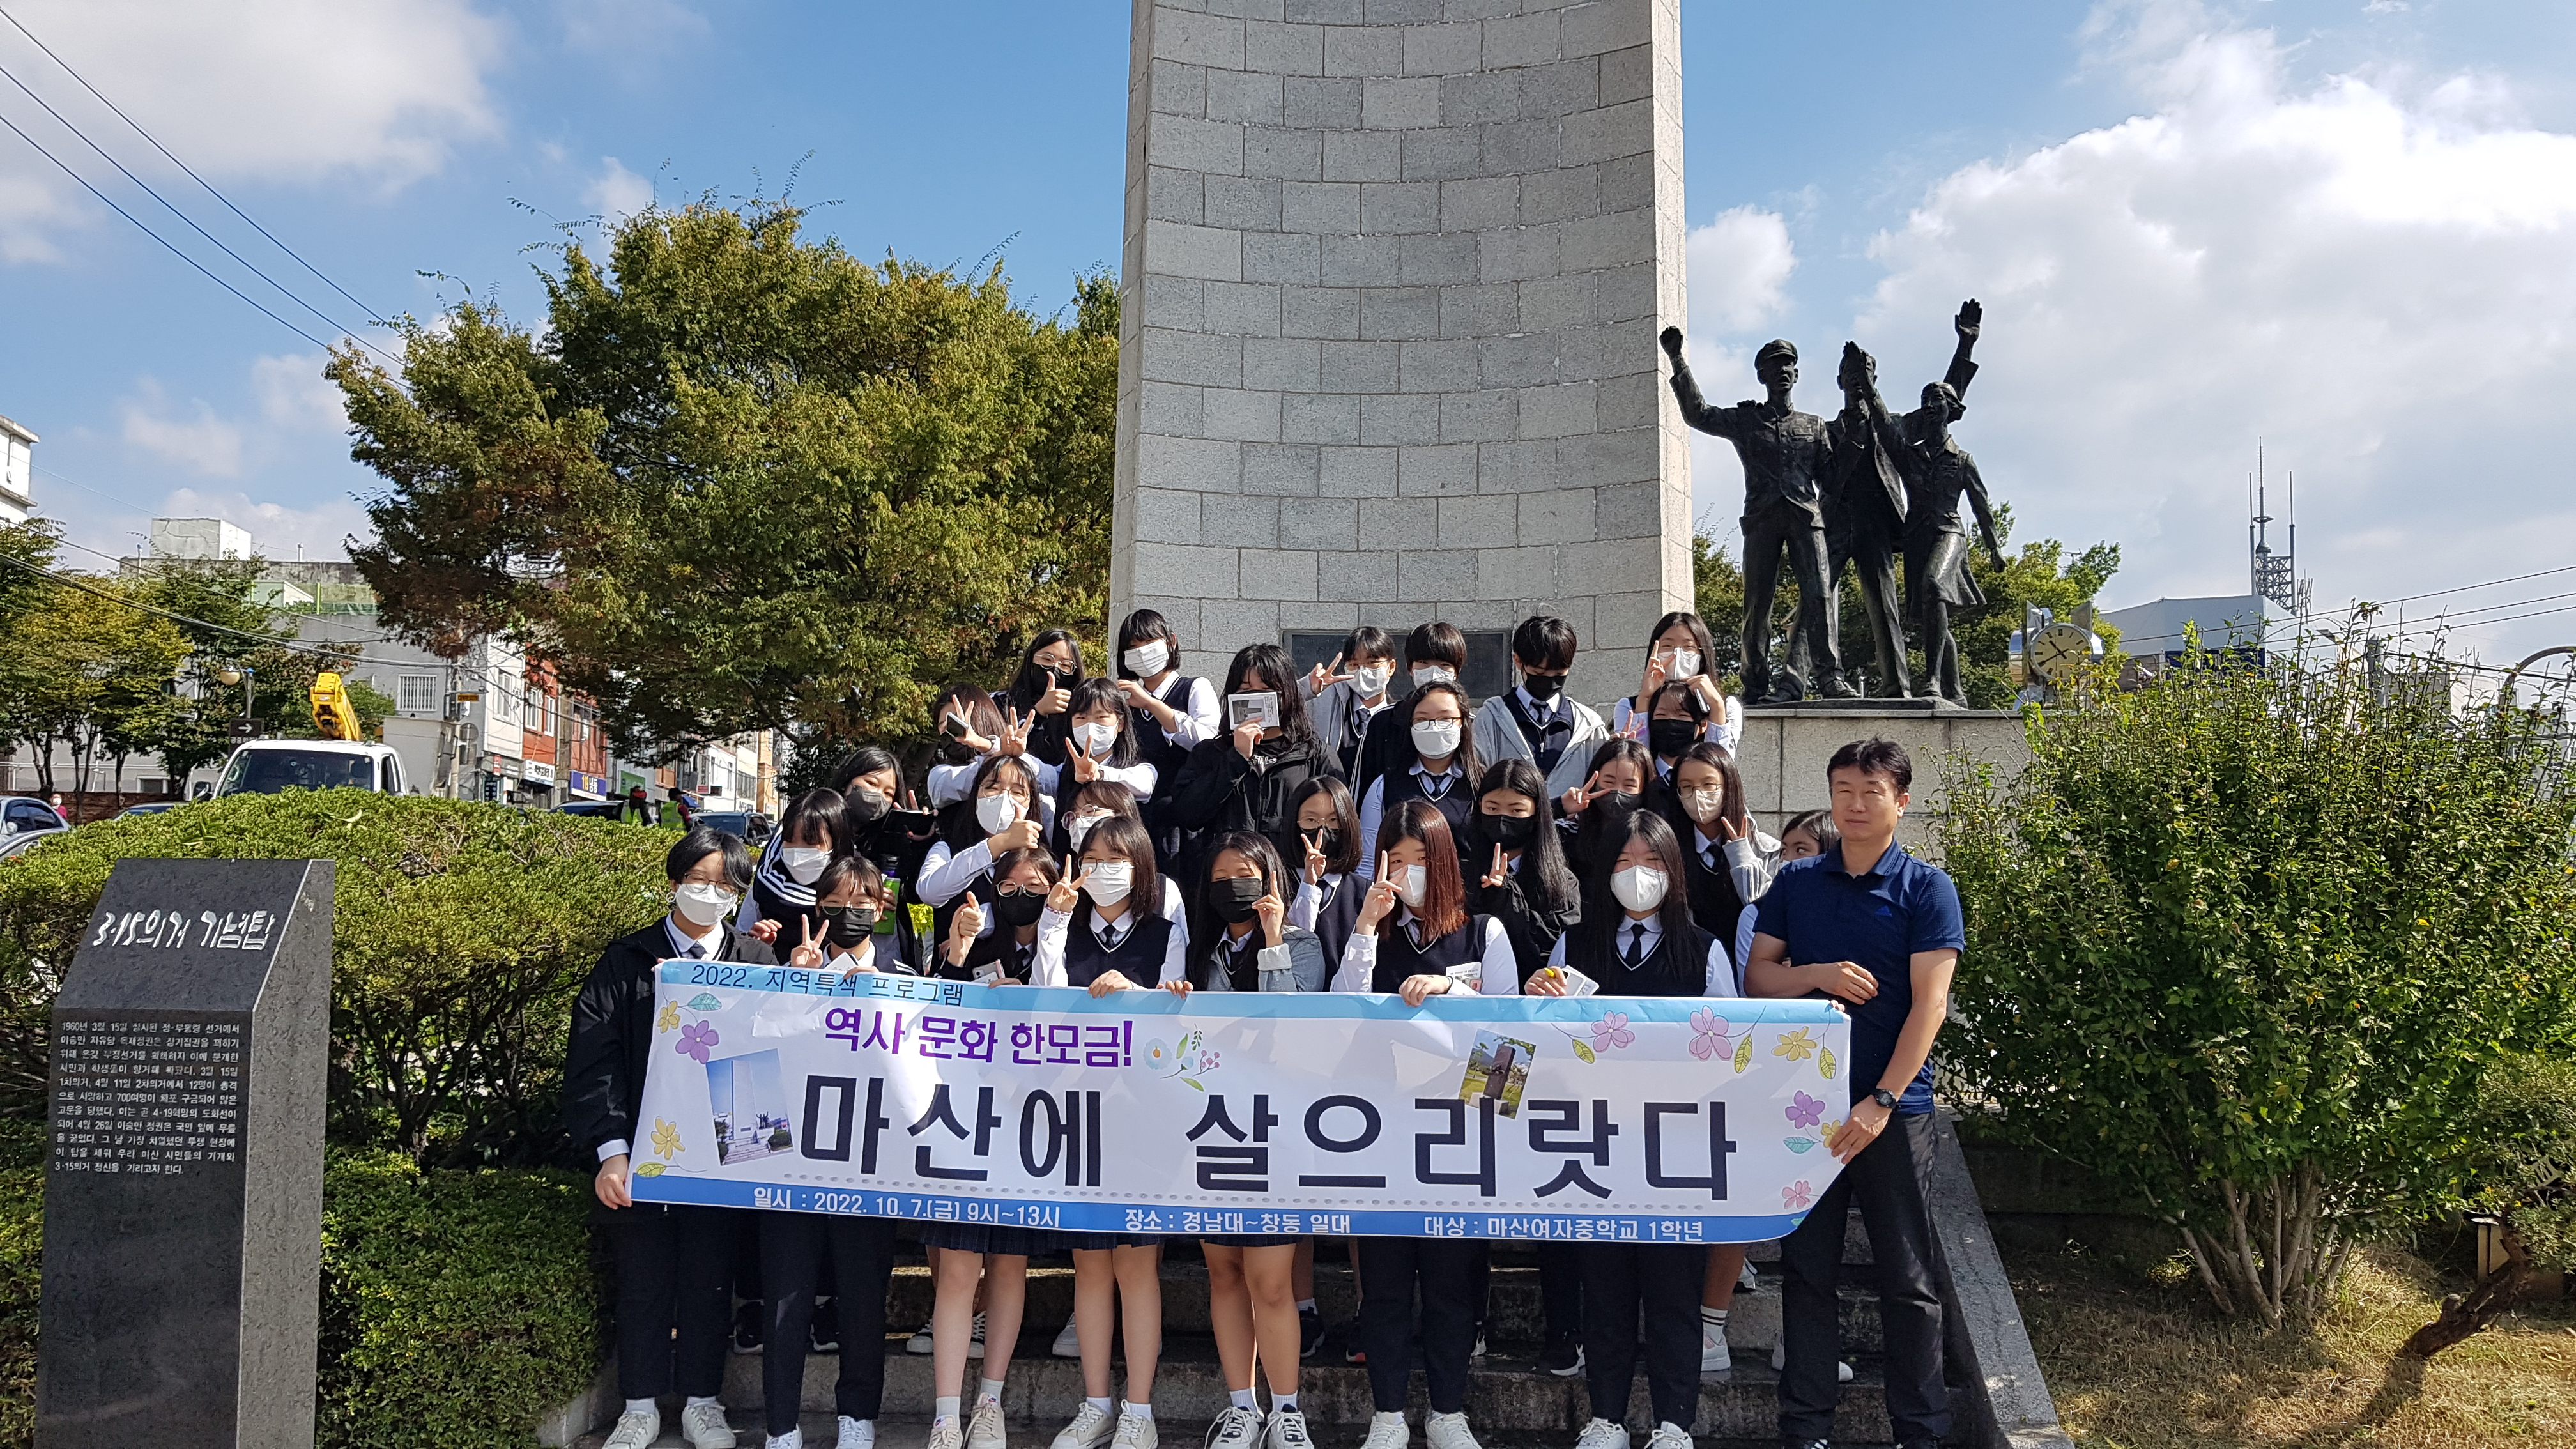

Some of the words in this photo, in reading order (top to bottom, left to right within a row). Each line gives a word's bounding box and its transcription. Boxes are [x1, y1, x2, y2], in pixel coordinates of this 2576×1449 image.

[200, 910, 276, 950] 기념탑
[691, 965, 753, 989] 2022.
[765, 969, 858, 997] 지역특색
[868, 977, 963, 1007] 프로그램
[61, 1022, 88, 1031] 1960년
[91, 1022, 105, 1031] 3월
[111, 1023, 128, 1032] 15일
[132, 1023, 158, 1032] 실시된
[205, 1024, 240, 1034] 선거에서
[60, 1036, 86, 1045] 이승만
[89, 1036, 116, 1045] 자유당
[165, 1038, 209, 1047] 장기집권을
[824, 1007, 906, 1055] 역사
[918, 1016, 999, 1063] 문화
[1009, 1020, 1134, 1068] 한모금!
[59, 1049, 77, 1058] 위해
[190, 1052, 208, 1061] 이에
[212, 1053, 239, 1062] 분개한
[59, 1063, 86, 1073] 시민과
[133, 1065, 160, 1074] 항거해
[200, 1066, 214, 1076] 3월
[220, 1067, 238, 1077] 15일
[95, 1078, 109, 1087] 4월
[113, 1078, 131, 1088] 11일
[135, 1079, 184, 1089] 2차의거에서
[188, 1080, 215, 1089] 12명이
[57, 1092, 75, 1100] 으로
[79, 1092, 113, 1101] 사망하고
[116, 1092, 155, 1103] 700여명이
[181, 1094, 215, 1104] 구금되어
[57, 1105, 82, 1115] 고문을
[118, 1107, 136, 1116] 이는
[140, 1108, 149, 1117] 곧
[56, 1120, 73, 1129] 되어
[77, 1120, 91, 1130] 4월
[95, 1121, 113, 1130] 26일
[117, 1121, 142, 1131] 이승만
[146, 1122, 172, 1131] 정권은
[175, 1123, 193, 1132] 국민
[56, 1133, 65, 1142] 을
[114, 1135, 123, 1144] 날
[127, 1136, 145, 1145] 가장
[800, 1074, 1102, 1187] 마산에
[1184, 1093, 1738, 1201] 살으리랏다
[56, 1147, 65, 1156] 이
[70, 1148, 88, 1157] 탑을
[93, 1149, 112, 1158] 세워
[117, 1149, 135, 1158] 우리
[141, 1150, 159, 1160] 마산
[164, 1151, 202, 1160] 시민들의
[207, 1152, 234, 1162] 기개와
[94, 1163, 119, 1172] 정신을
[126, 1164, 160, 1174] 기리고자
[164, 1165, 184, 1174] 한다.
[753, 1186, 792, 1209] 일시
[813, 1192, 868, 1214] 2022.
[875, 1196, 903, 1216] 10.
[967, 1202, 1061, 1228] 9시~13시
[1124, 1208, 1163, 1232] 장소
[1182, 1211, 1301, 1234] 경남대~창동
[1310, 1214, 1351, 1234] 일대
[1423, 1216, 1466, 1238] 대상
[1487, 1217, 1639, 1240] 마산여자중학교
[1648, 1220, 1704, 1243] 1학년
